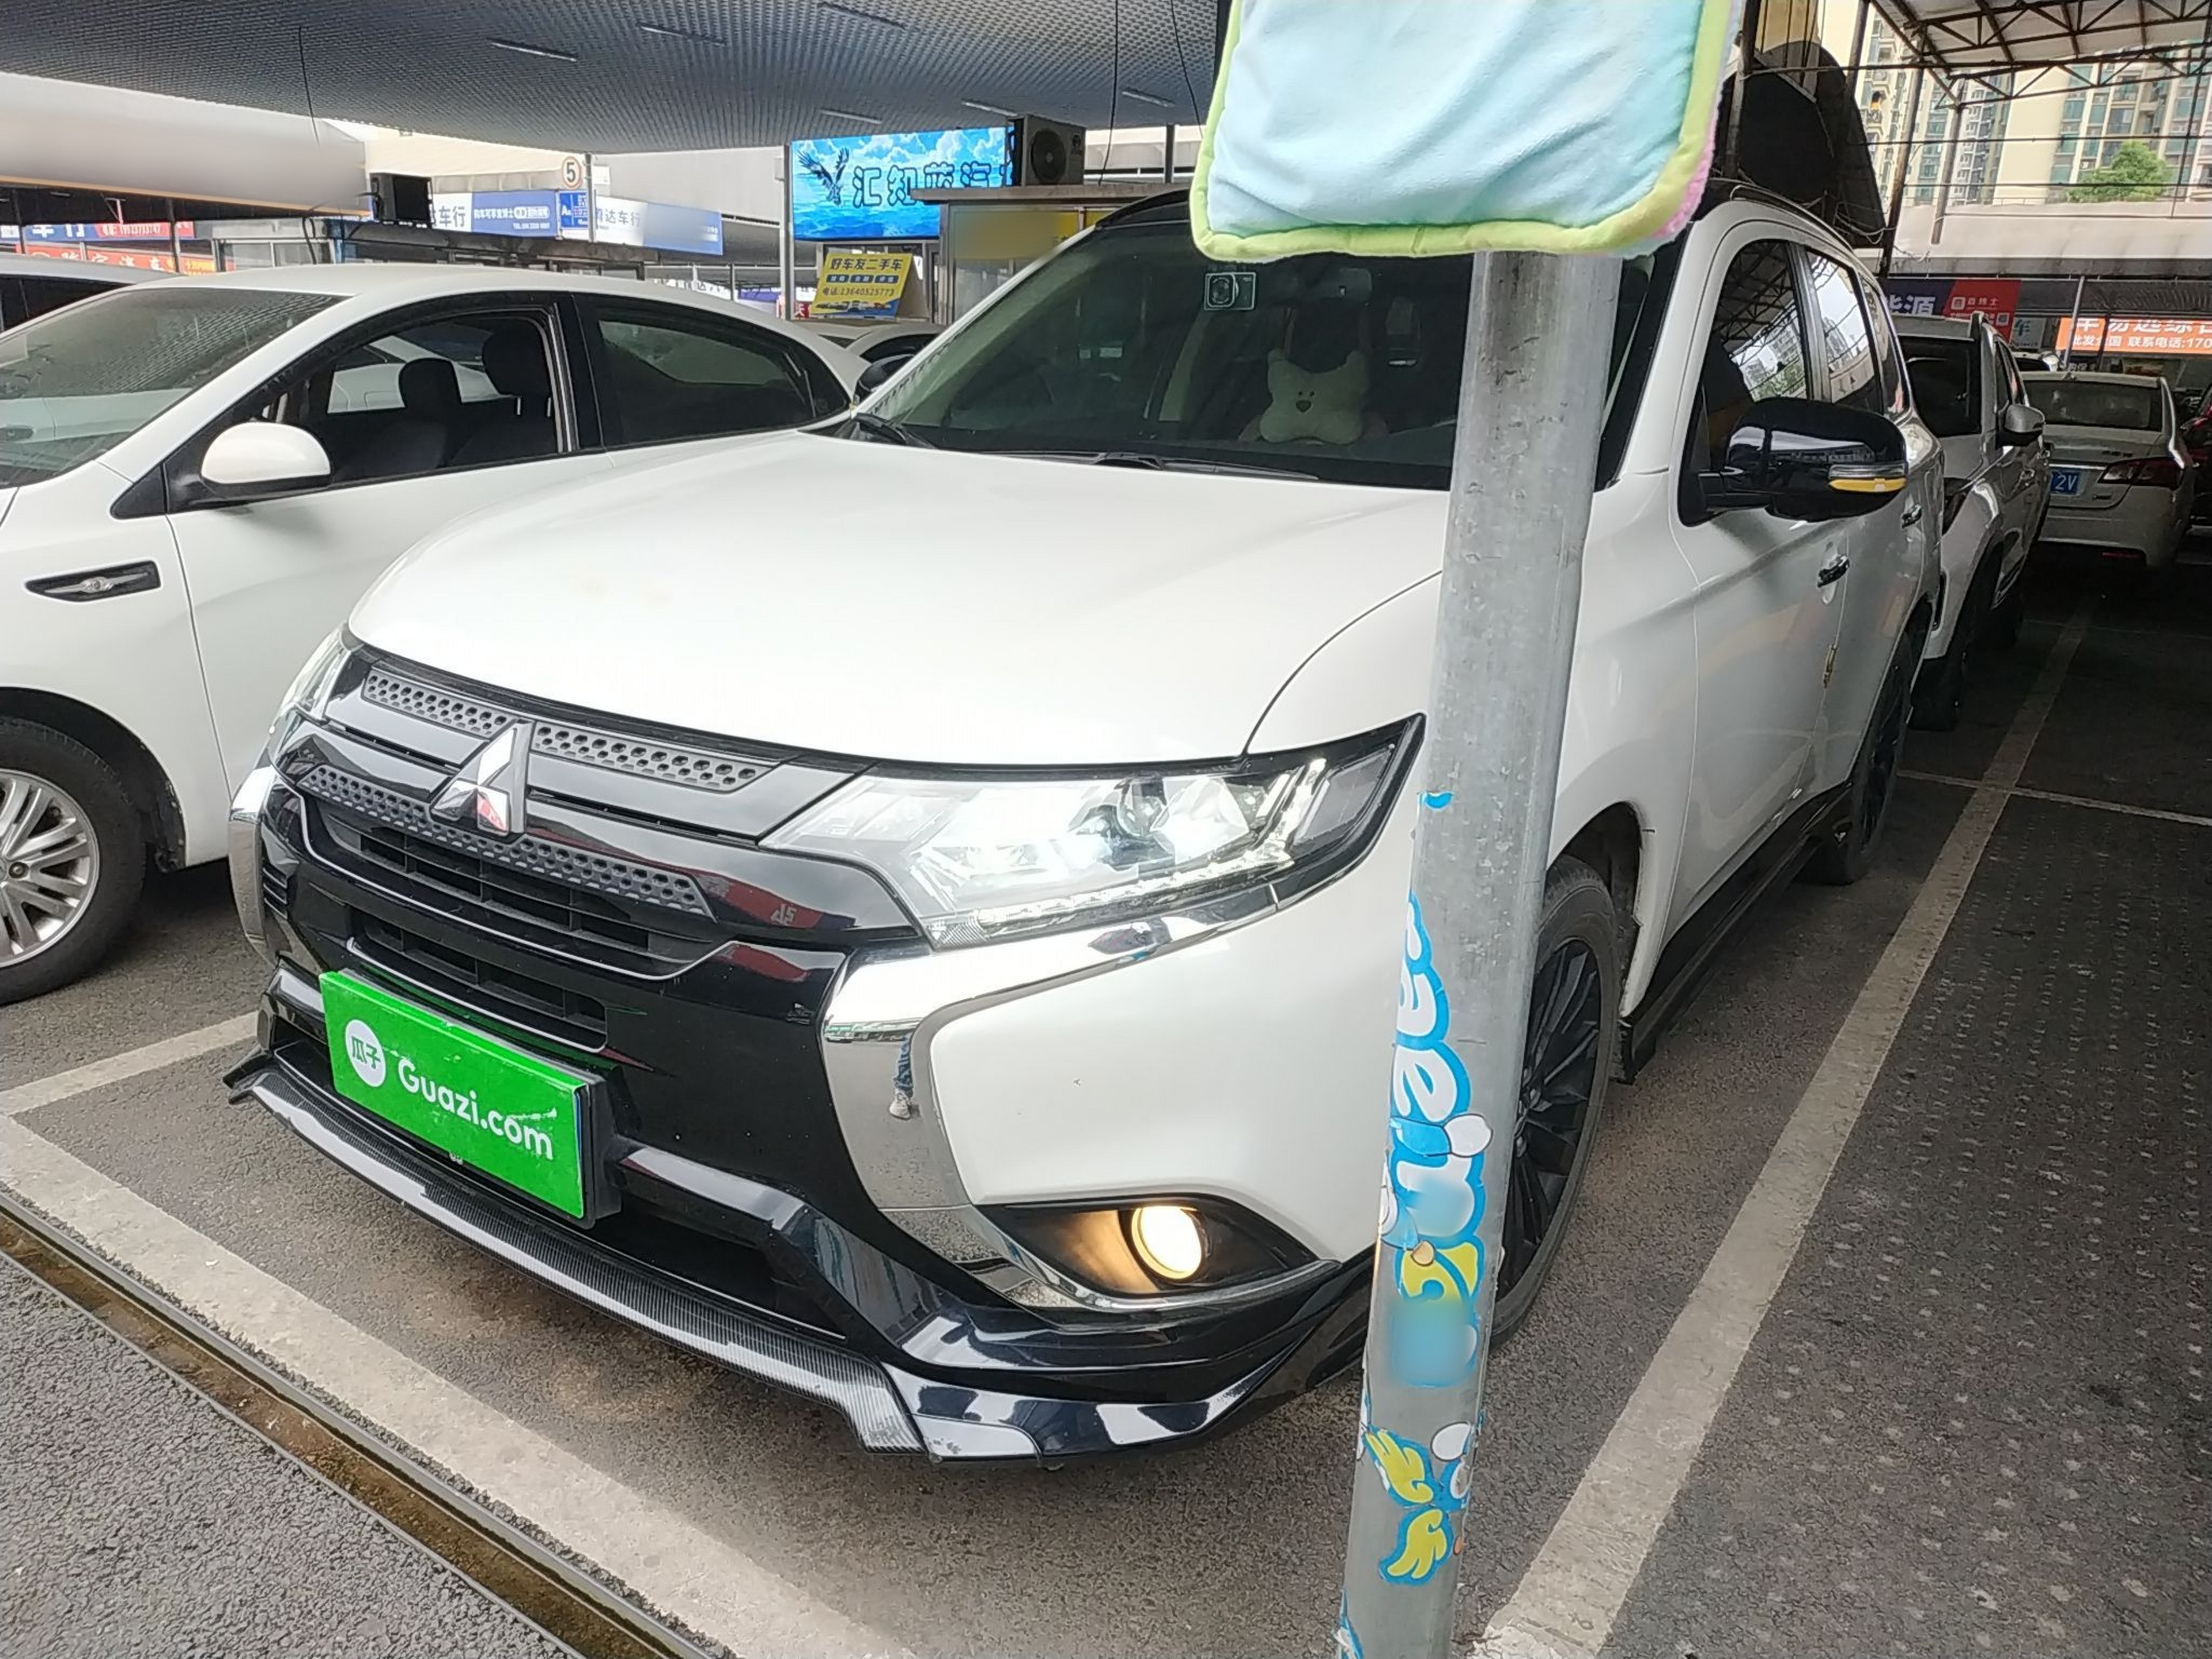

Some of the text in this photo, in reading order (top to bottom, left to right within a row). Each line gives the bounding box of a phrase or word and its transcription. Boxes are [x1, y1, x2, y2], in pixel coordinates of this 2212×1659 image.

[566, 162, 576, 182] 5
[830, 258, 903, 271] 好车友二手车
[351, 1035, 381, 1070] 瓜子
[397, 1057, 554, 1161] Guazi.com
